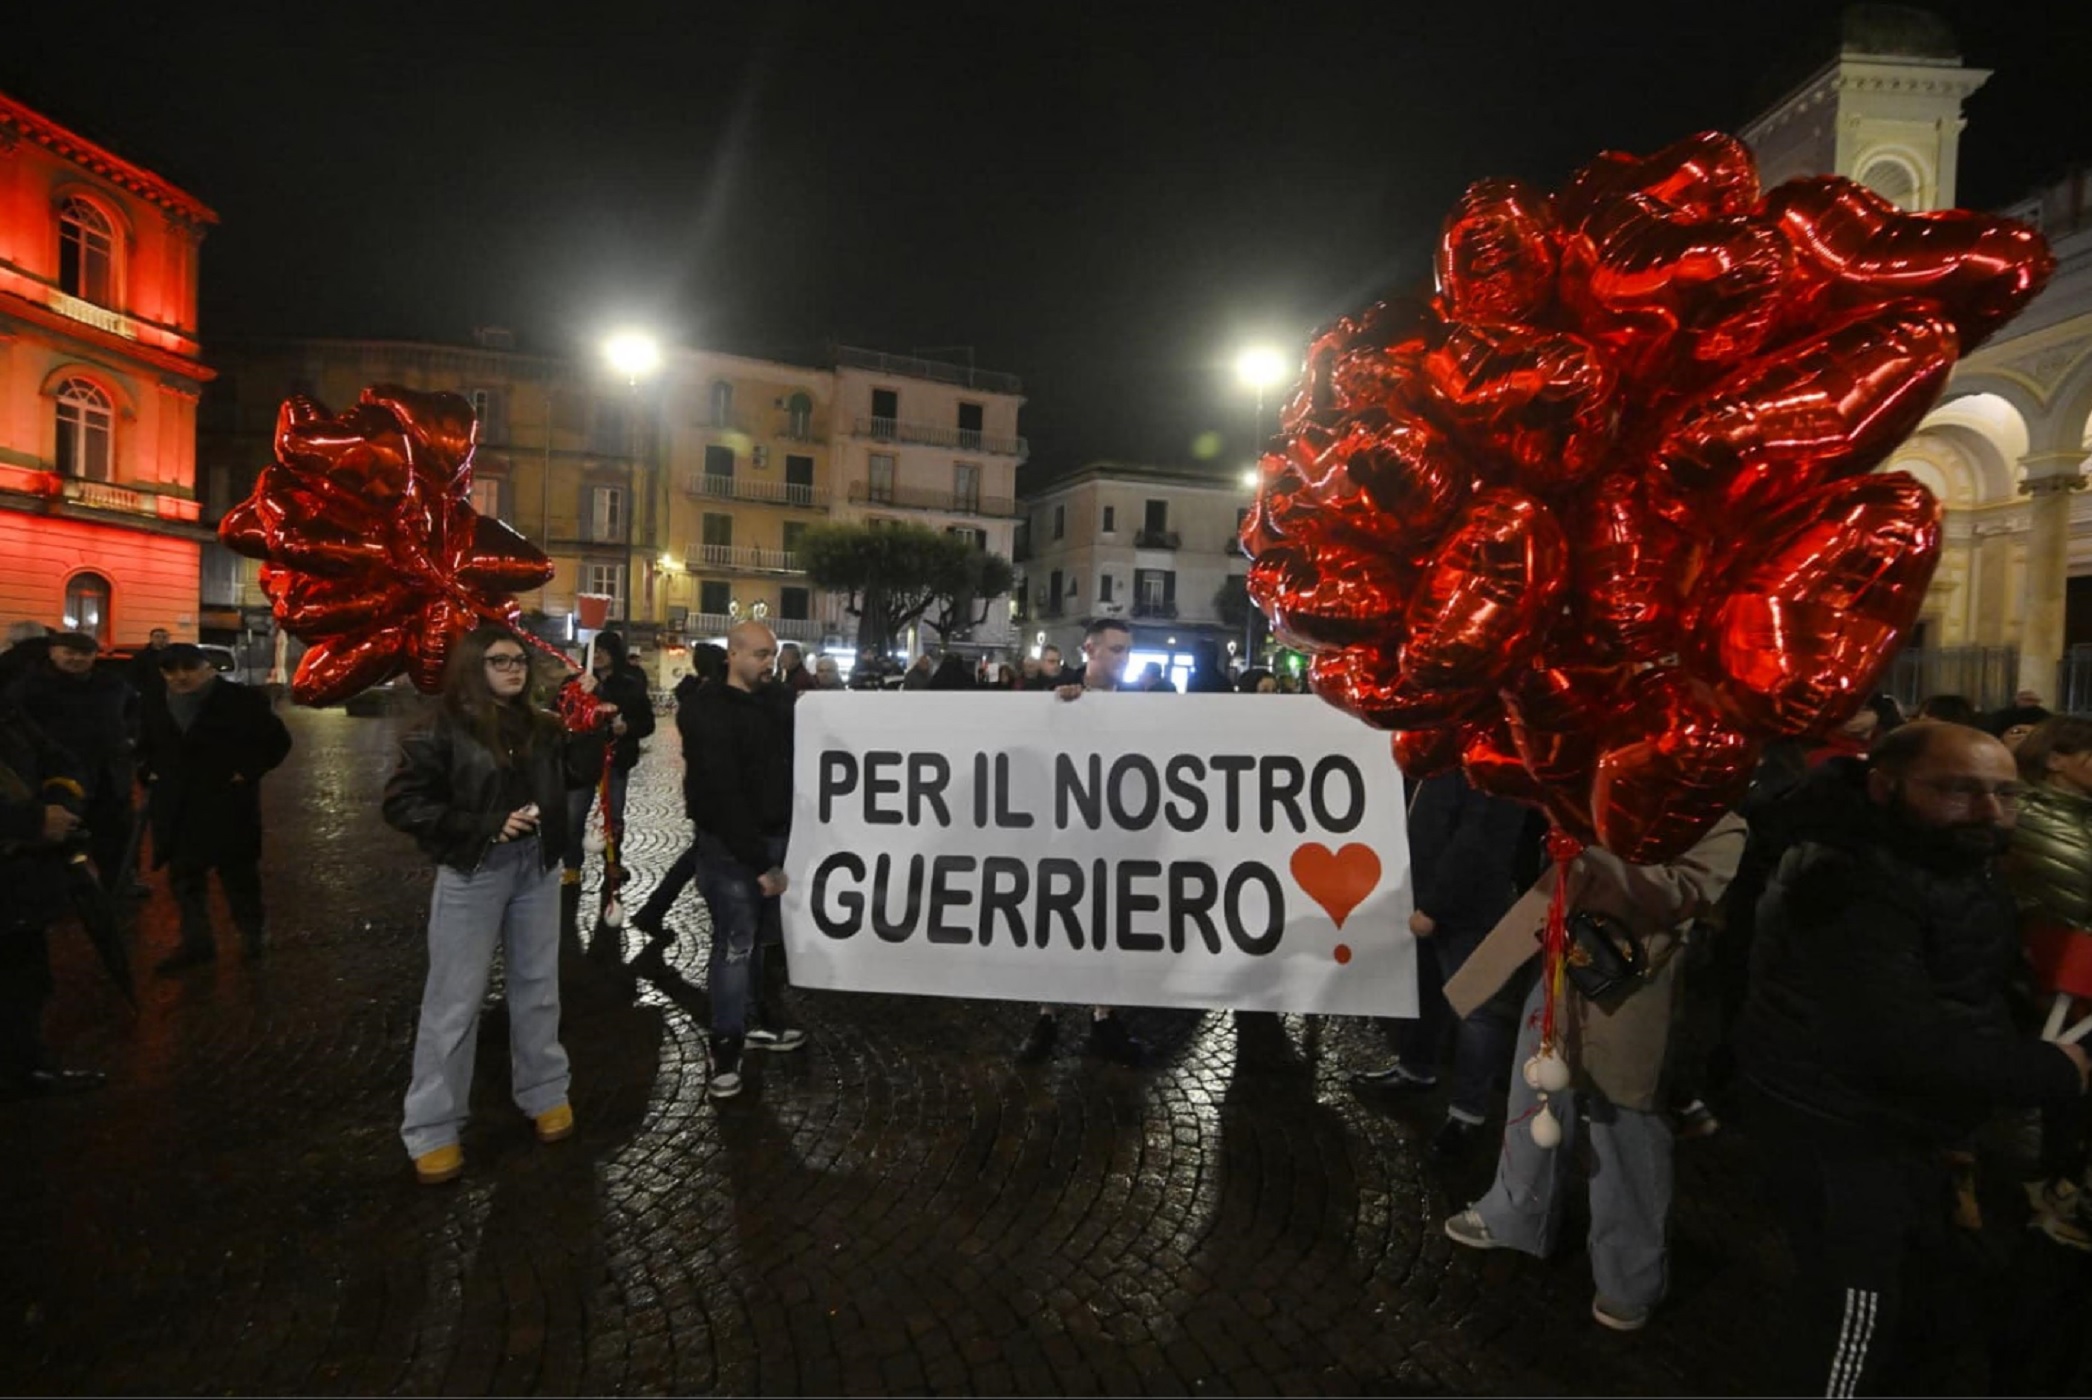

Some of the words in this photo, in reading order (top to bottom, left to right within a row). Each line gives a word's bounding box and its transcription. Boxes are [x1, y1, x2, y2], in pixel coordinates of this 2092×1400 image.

[818, 750, 951, 828] PER
[973, 752, 1034, 829] IL
[1055, 752, 1366, 834] NOSTRO
